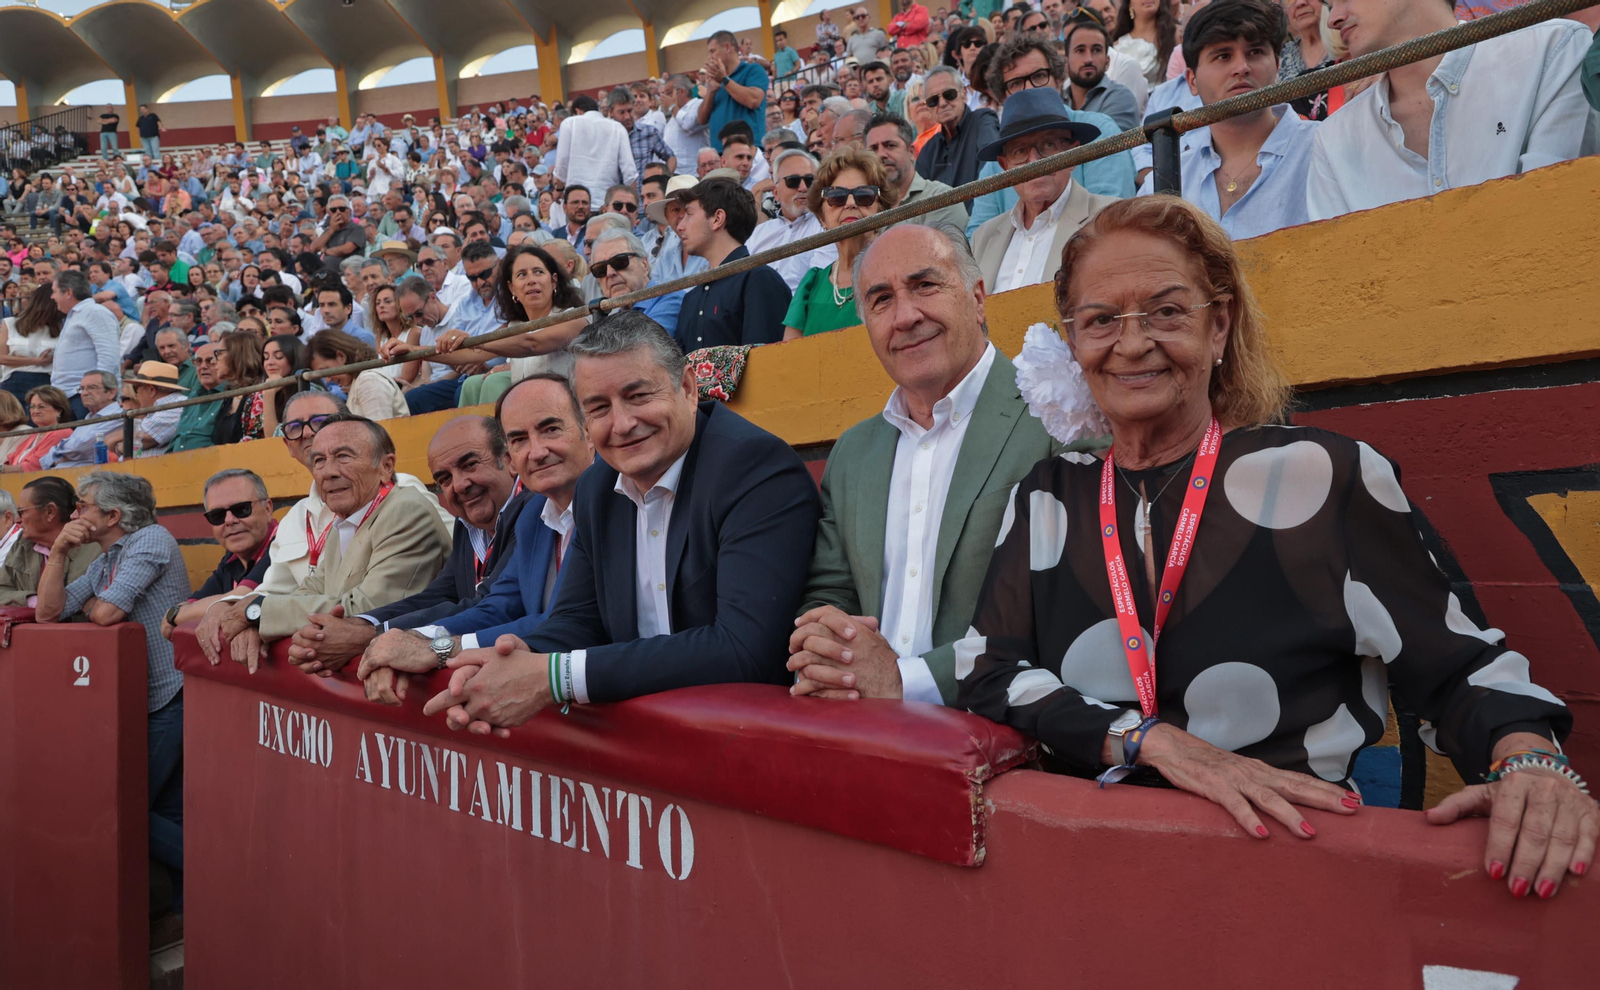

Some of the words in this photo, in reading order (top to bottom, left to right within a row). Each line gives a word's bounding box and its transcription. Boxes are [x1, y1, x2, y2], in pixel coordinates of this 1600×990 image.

[1175, 507, 1190, 541] CARMELO
[1177, 513, 1197, 566] ESPECTÁCULOS
[1114, 554, 1126, 581] GARCÍA
[1168, 541, 1180, 568] GARCÍA
[1108, 560, 1126, 613] ESPECTÁCULOS
[1121, 581, 1135, 616] CARMELO
[73, 655, 91, 686] 2
[1142, 671, 1154, 698] GARCÍA
[258, 701, 333, 768] EXCMO
[355, 732, 695, 881] AYUNTAMIENTO
